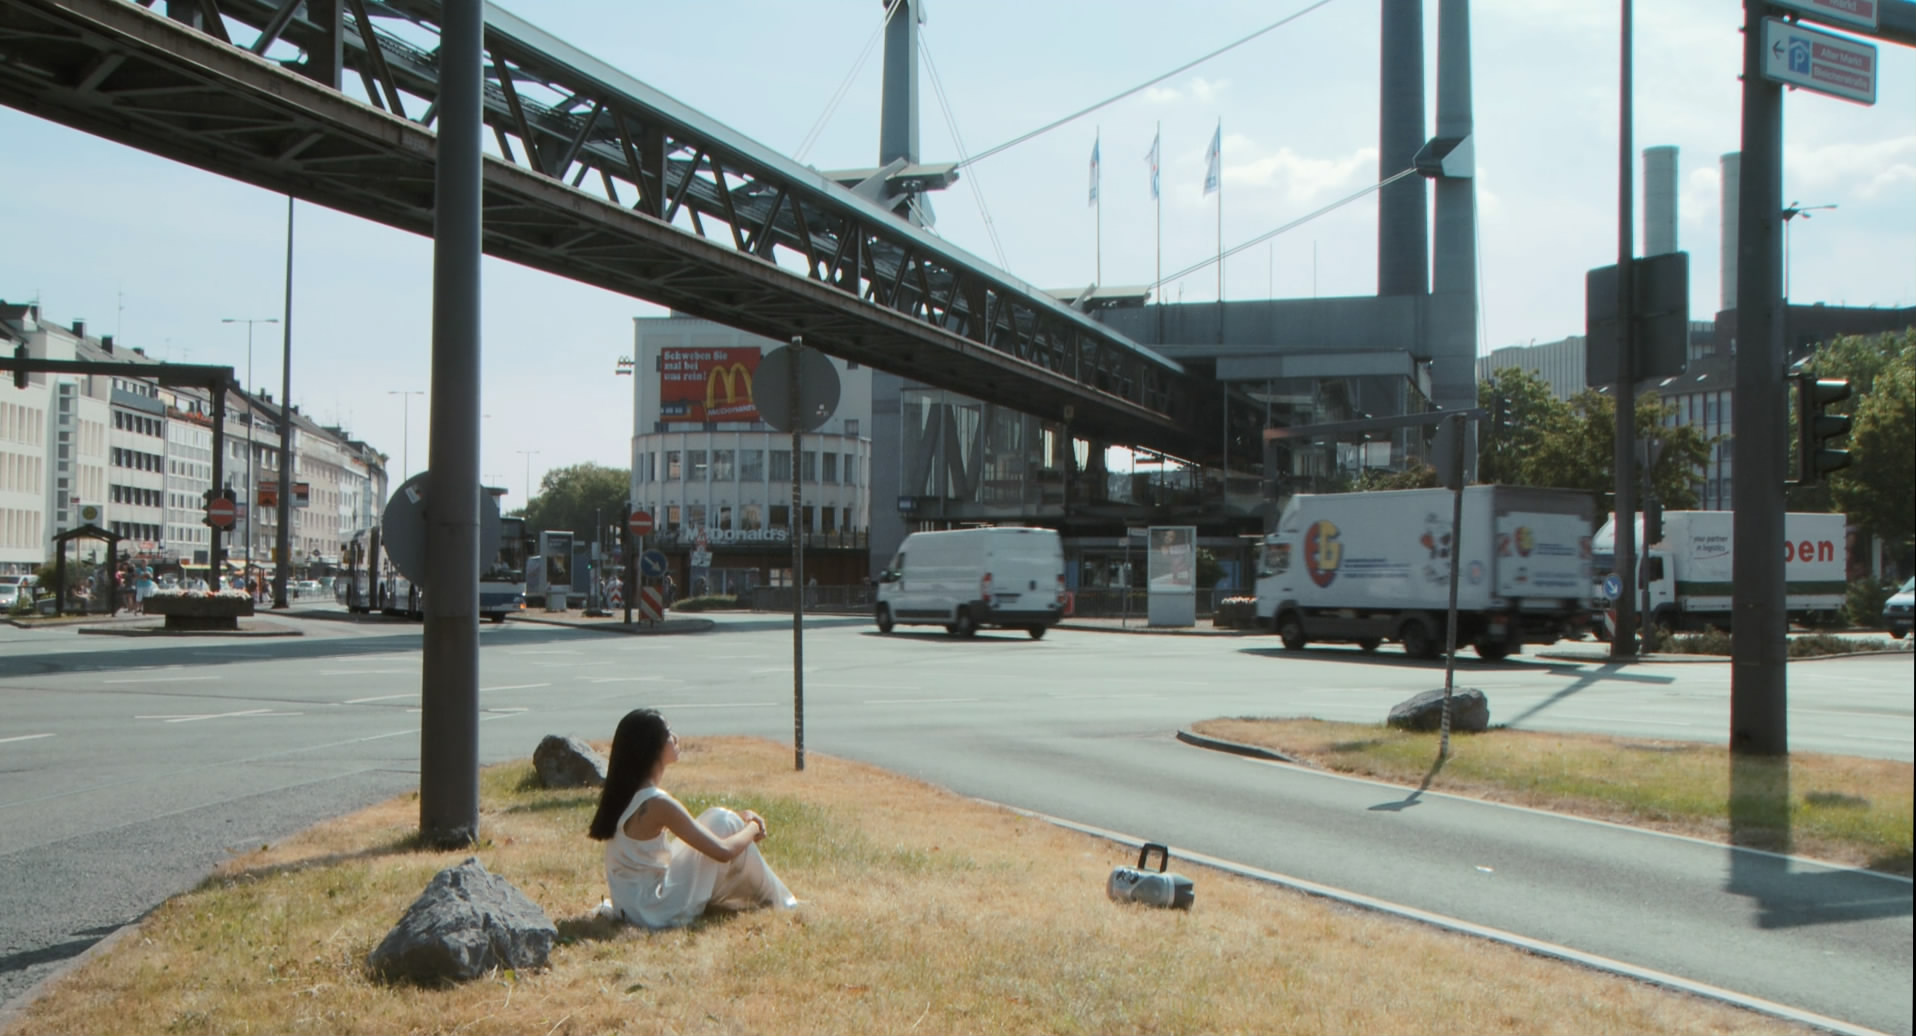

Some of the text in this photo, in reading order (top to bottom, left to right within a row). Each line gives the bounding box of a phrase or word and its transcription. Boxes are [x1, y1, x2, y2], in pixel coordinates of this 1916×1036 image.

[1820, 47, 1839, 60] Alter
[1839, 52, 1863, 67] Markt
[664, 351, 728, 360] Schweben Sie
[664, 361, 698, 370] mal bei
[664, 371, 707, 381] uns rein!
[1693, 536, 1728, 544] your partner
[1703, 544, 1726, 553] logistics
